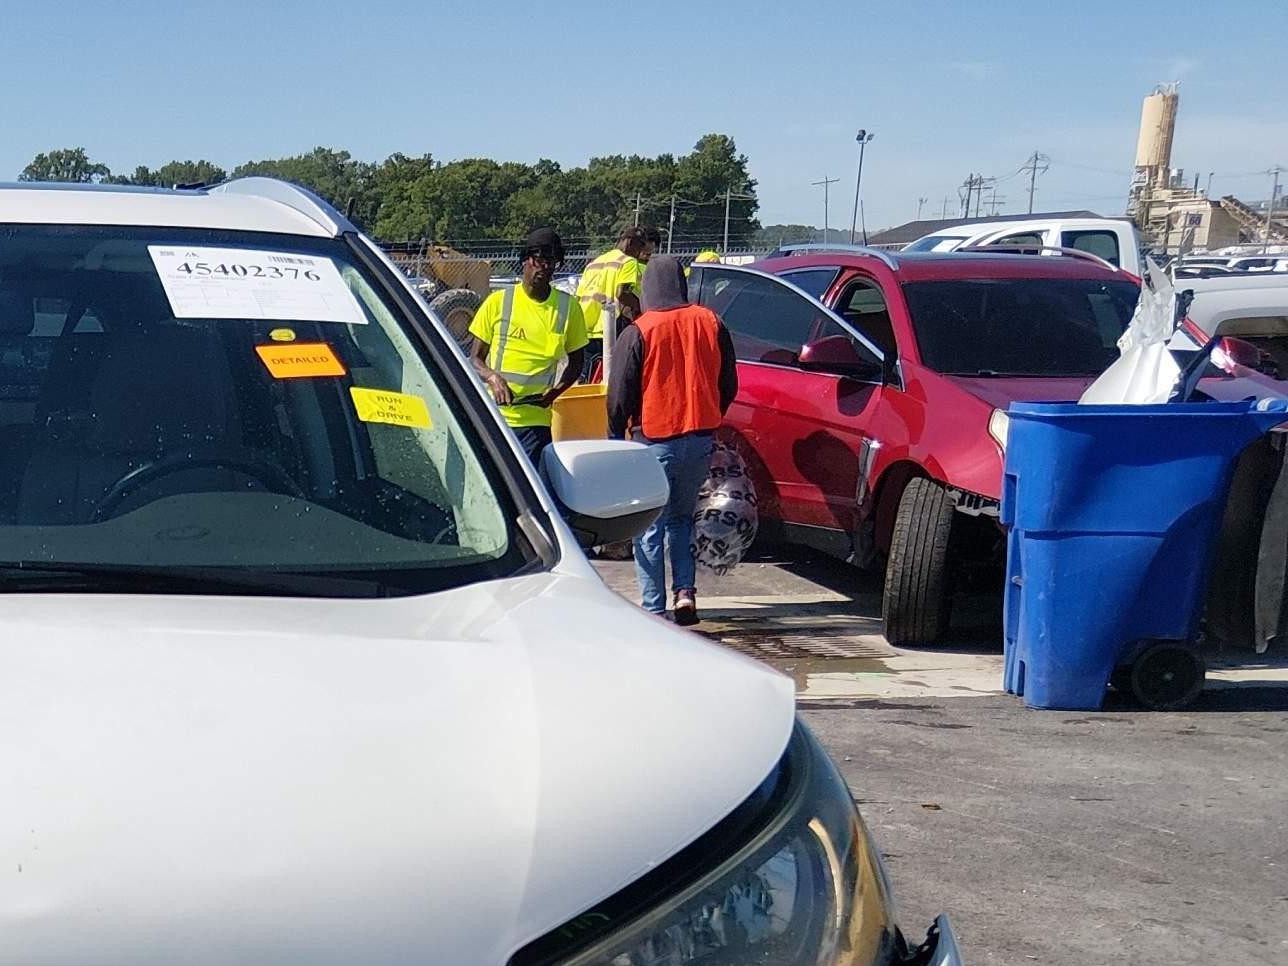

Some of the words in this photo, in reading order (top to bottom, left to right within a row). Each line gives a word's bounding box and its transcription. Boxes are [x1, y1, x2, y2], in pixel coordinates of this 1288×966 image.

[176, 262, 321, 281] 45402376
[271, 356, 329, 365] DETAILED
[376, 395, 403, 405] RUN
[376, 411, 414, 422] DRIVE
